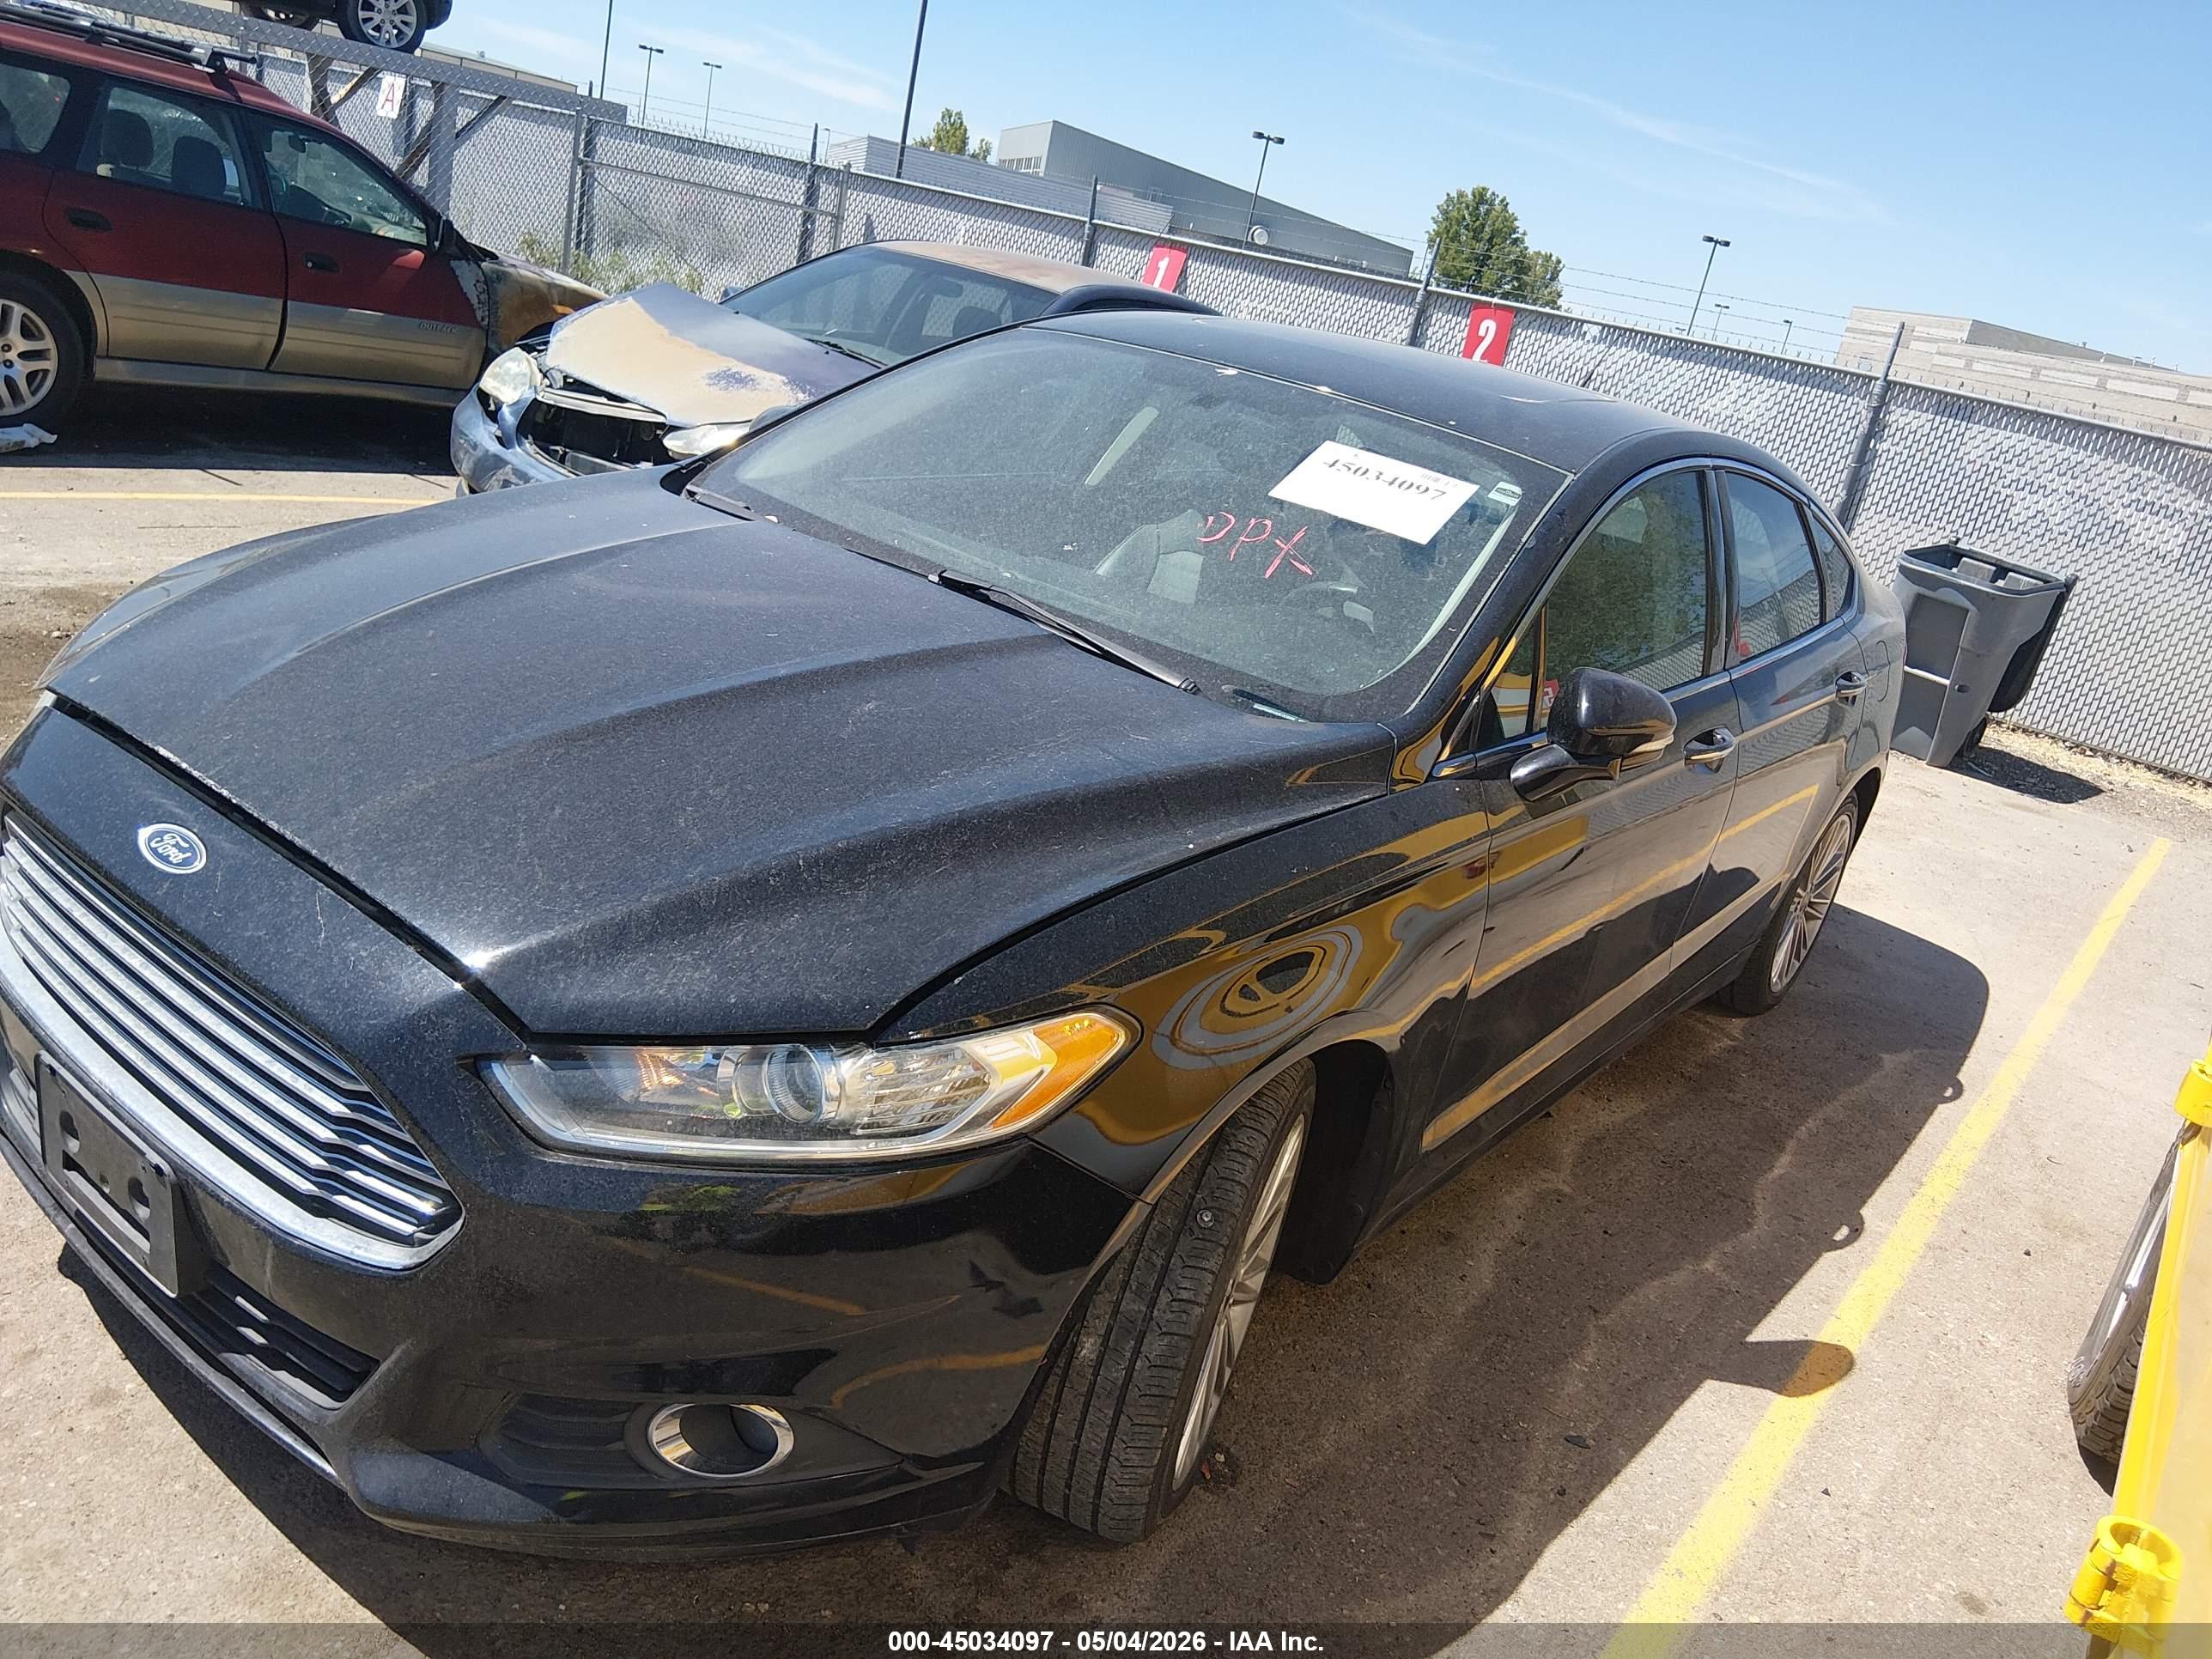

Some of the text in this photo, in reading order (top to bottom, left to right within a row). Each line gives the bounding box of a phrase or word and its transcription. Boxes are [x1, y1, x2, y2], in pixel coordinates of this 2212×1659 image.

[380, 82, 395, 112] A
[1152, 256, 1170, 289] 1
[1471, 319, 1498, 363] 2
[1323, 458, 1448, 501] 45034097
[1196, 511, 1313, 580] DPX
[149, 833, 192, 864] Ford
